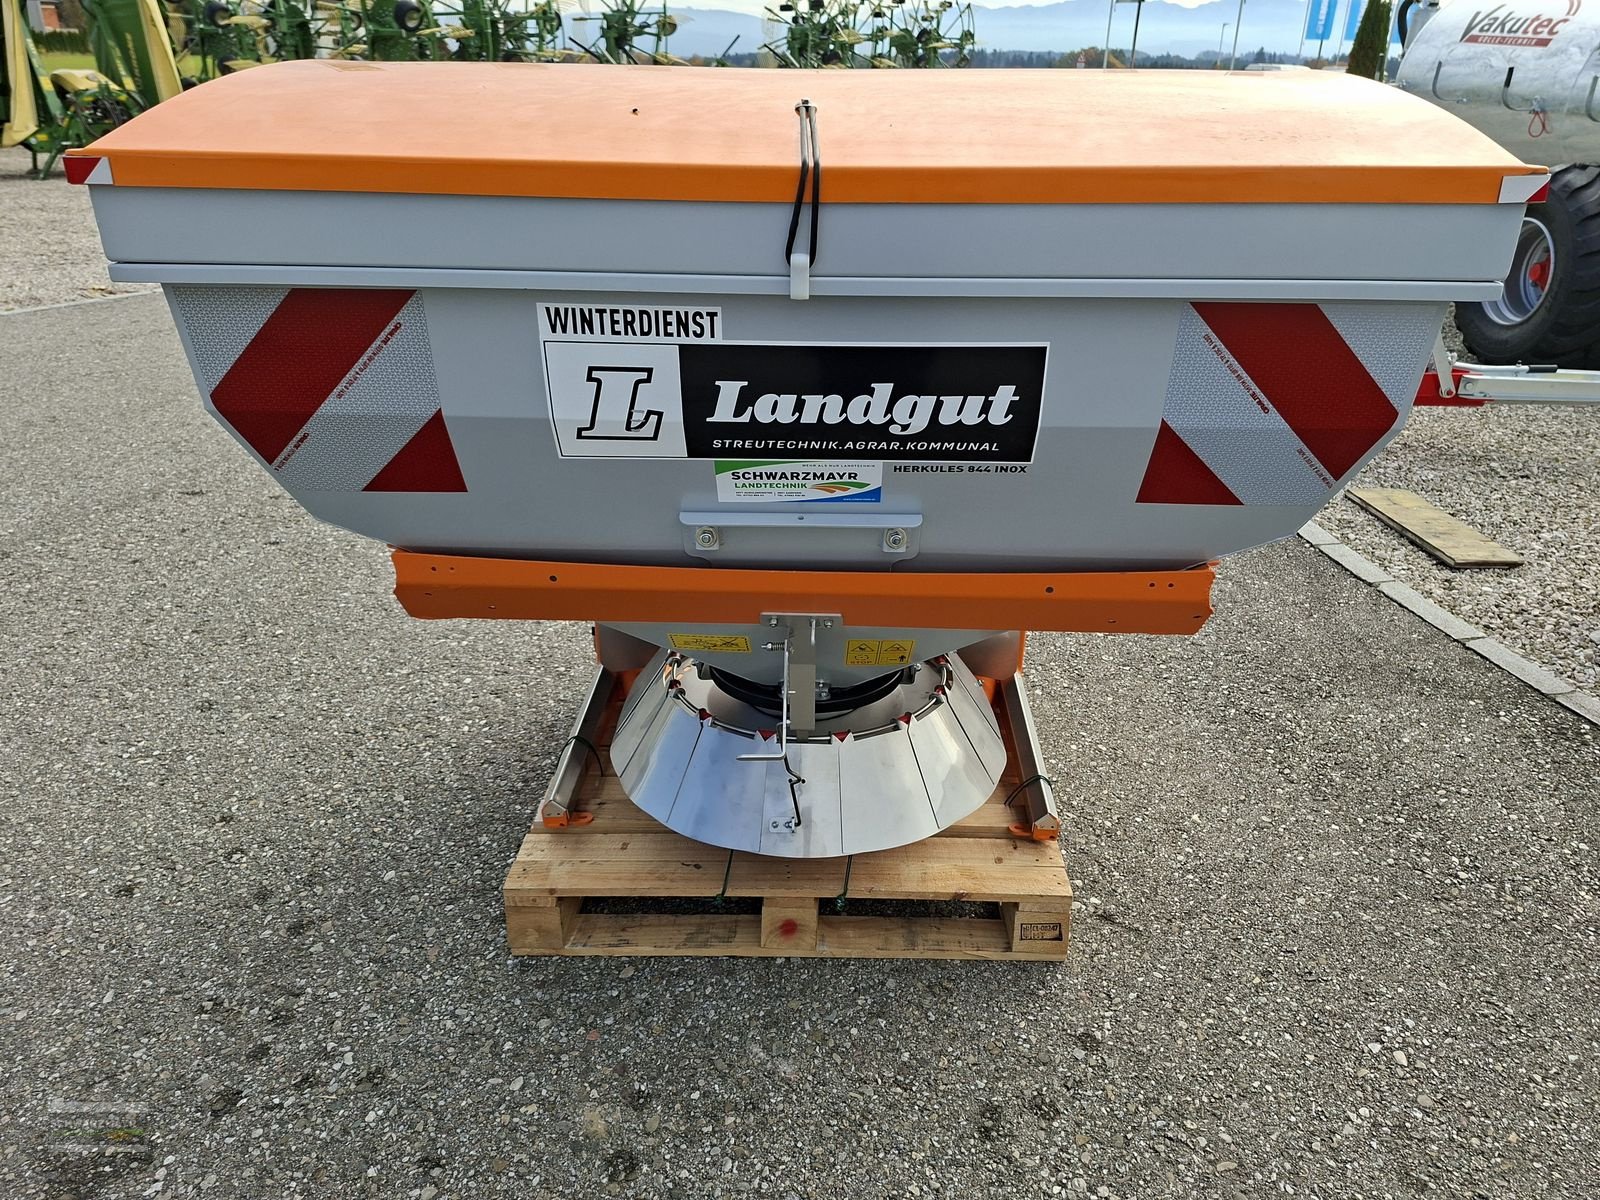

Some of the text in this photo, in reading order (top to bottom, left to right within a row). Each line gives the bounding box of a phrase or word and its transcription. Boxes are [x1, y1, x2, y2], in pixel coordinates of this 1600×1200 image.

[1459, 4, 1570, 43] Vakutec
[545, 306, 718, 339] WINTERDIENST
[576, 366, 664, 441] L
[706, 380, 1020, 435] Landgut
[731, 471, 858, 481] SCHWARZMAYR
[893, 465, 1028, 474] HERKULES 844 INOX
